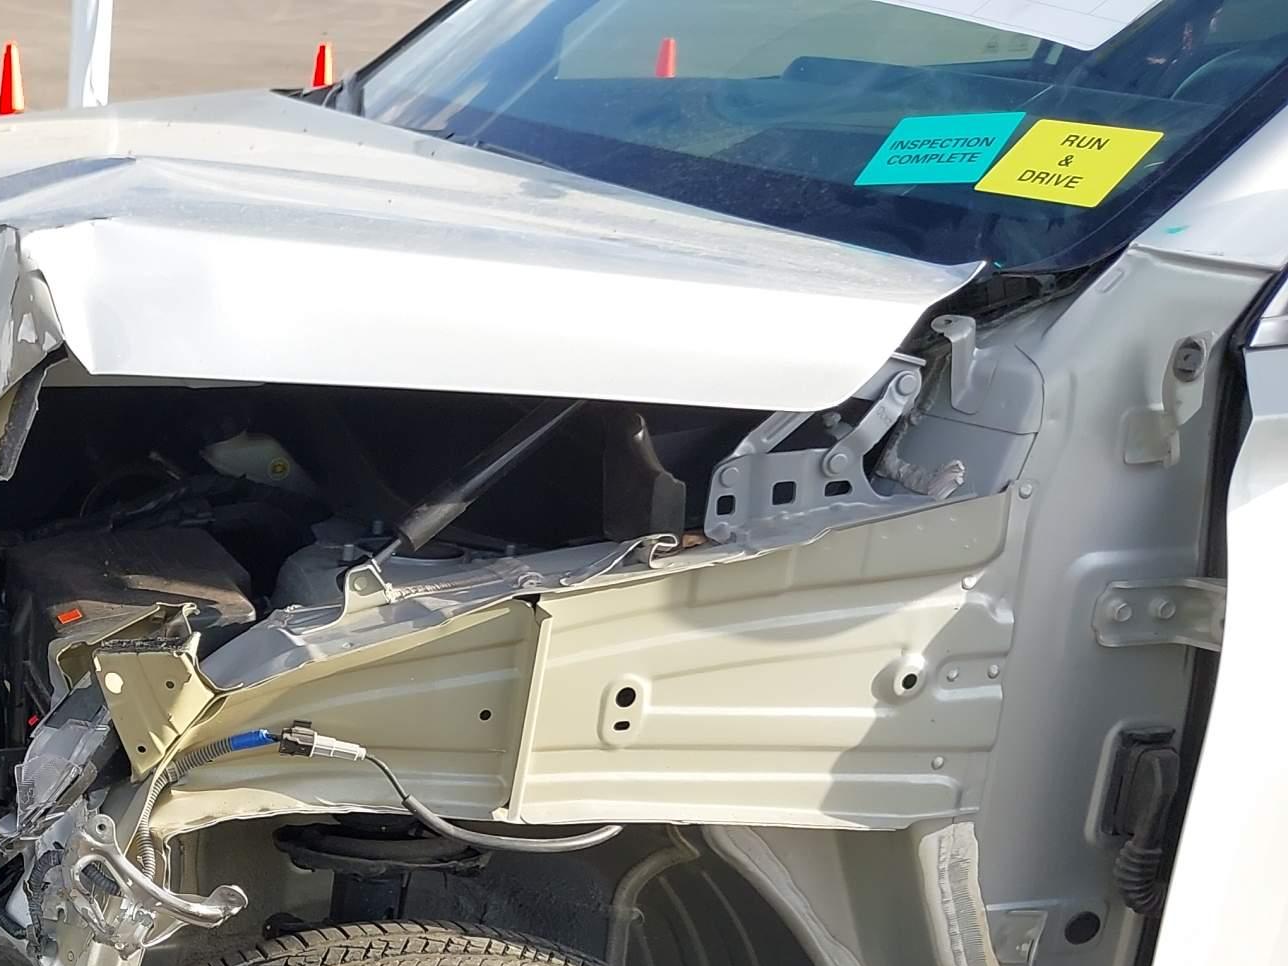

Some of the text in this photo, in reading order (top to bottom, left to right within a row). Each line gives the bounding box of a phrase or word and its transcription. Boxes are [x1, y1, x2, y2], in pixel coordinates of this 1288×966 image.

[889, 136, 995, 151] INSPECTION
[1059, 134, 1111, 151] RUN
[886, 151, 981, 166] COMPLETE
[1057, 154, 1074, 167] &
[1016, 169, 1084, 189] DRIVE
